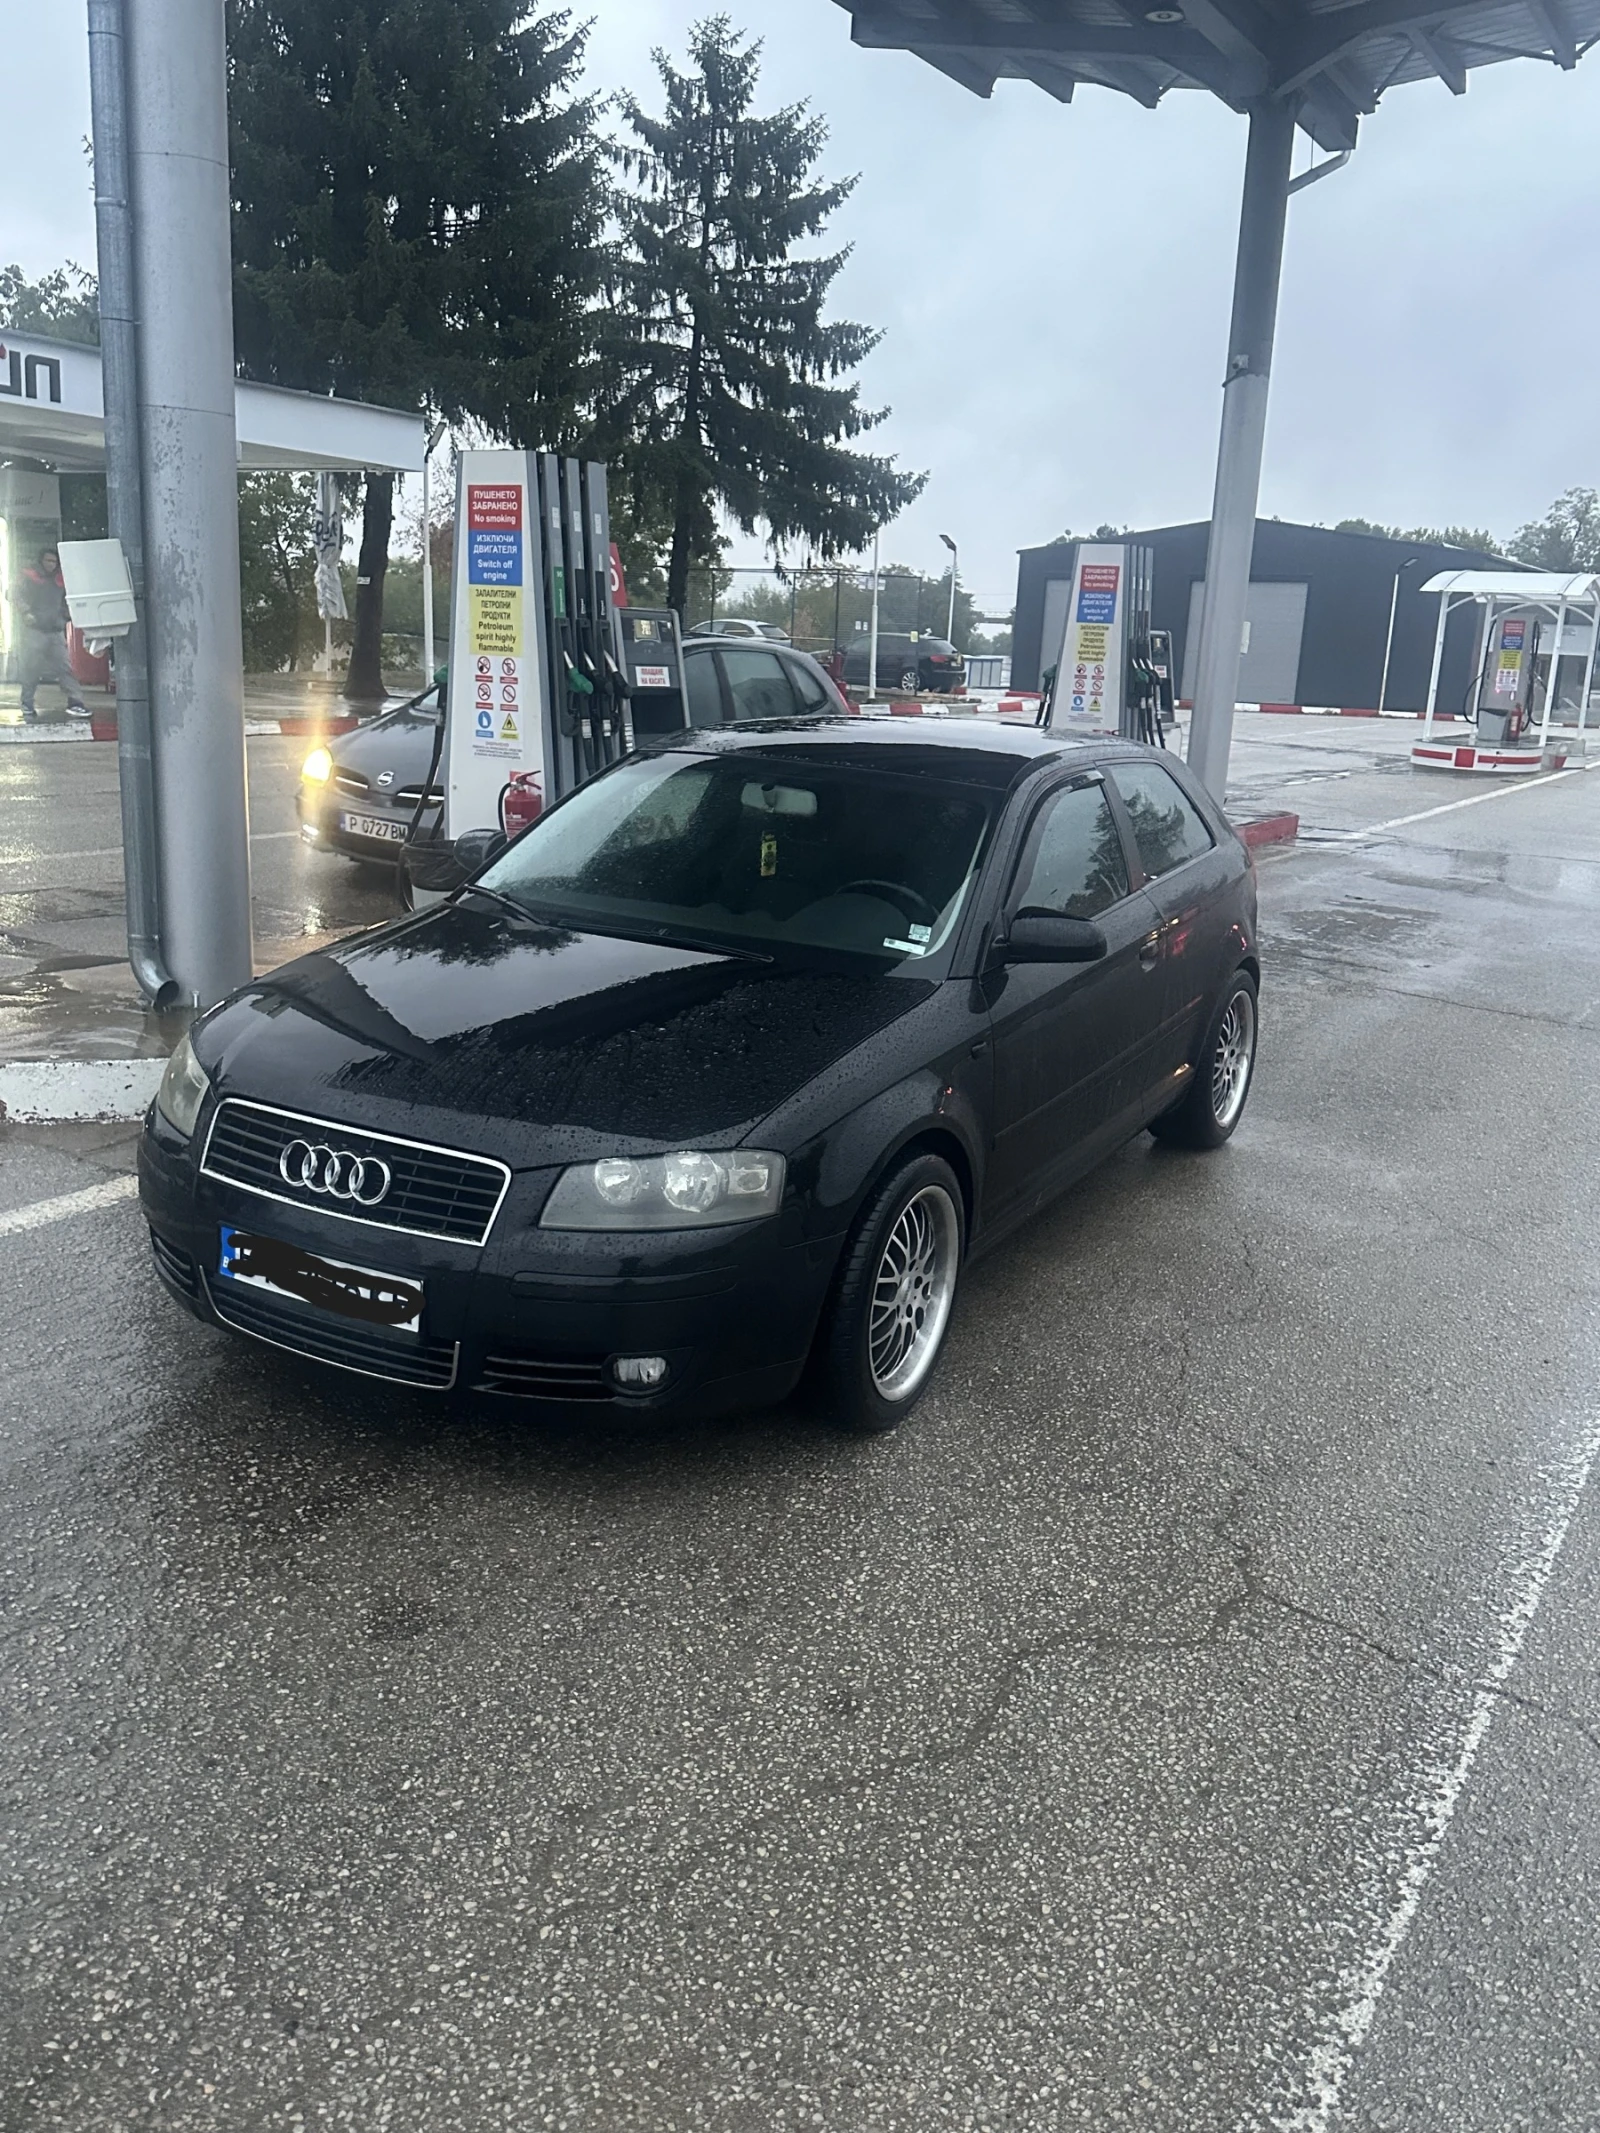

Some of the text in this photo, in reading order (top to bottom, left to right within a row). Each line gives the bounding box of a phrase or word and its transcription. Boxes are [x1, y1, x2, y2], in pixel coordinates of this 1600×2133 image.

[474, 490, 516, 499] ПУШЕНЕТО
[472, 501, 518, 510] ЗАБРАНЕНО
[474, 513, 516, 525] No smoking
[476, 534, 514, 542] ИЗКЛЮЧИ
[473, 545, 518, 554] ДВИГАТЕЛЯ
[477, 558, 513, 569] Switch off
[483, 571, 507, 581] engine
[481, 600, 511, 609] ПЕТРОЛНИ
[481, 611, 511, 620] ПРОДУКТИ
[478, 621, 514, 631] Petroleum
[475, 633, 516, 644] spirit highly
[478, 643, 514, 652] flammable
[349, 816, 357, 830] P
[362, 818, 389, 837] 0727
